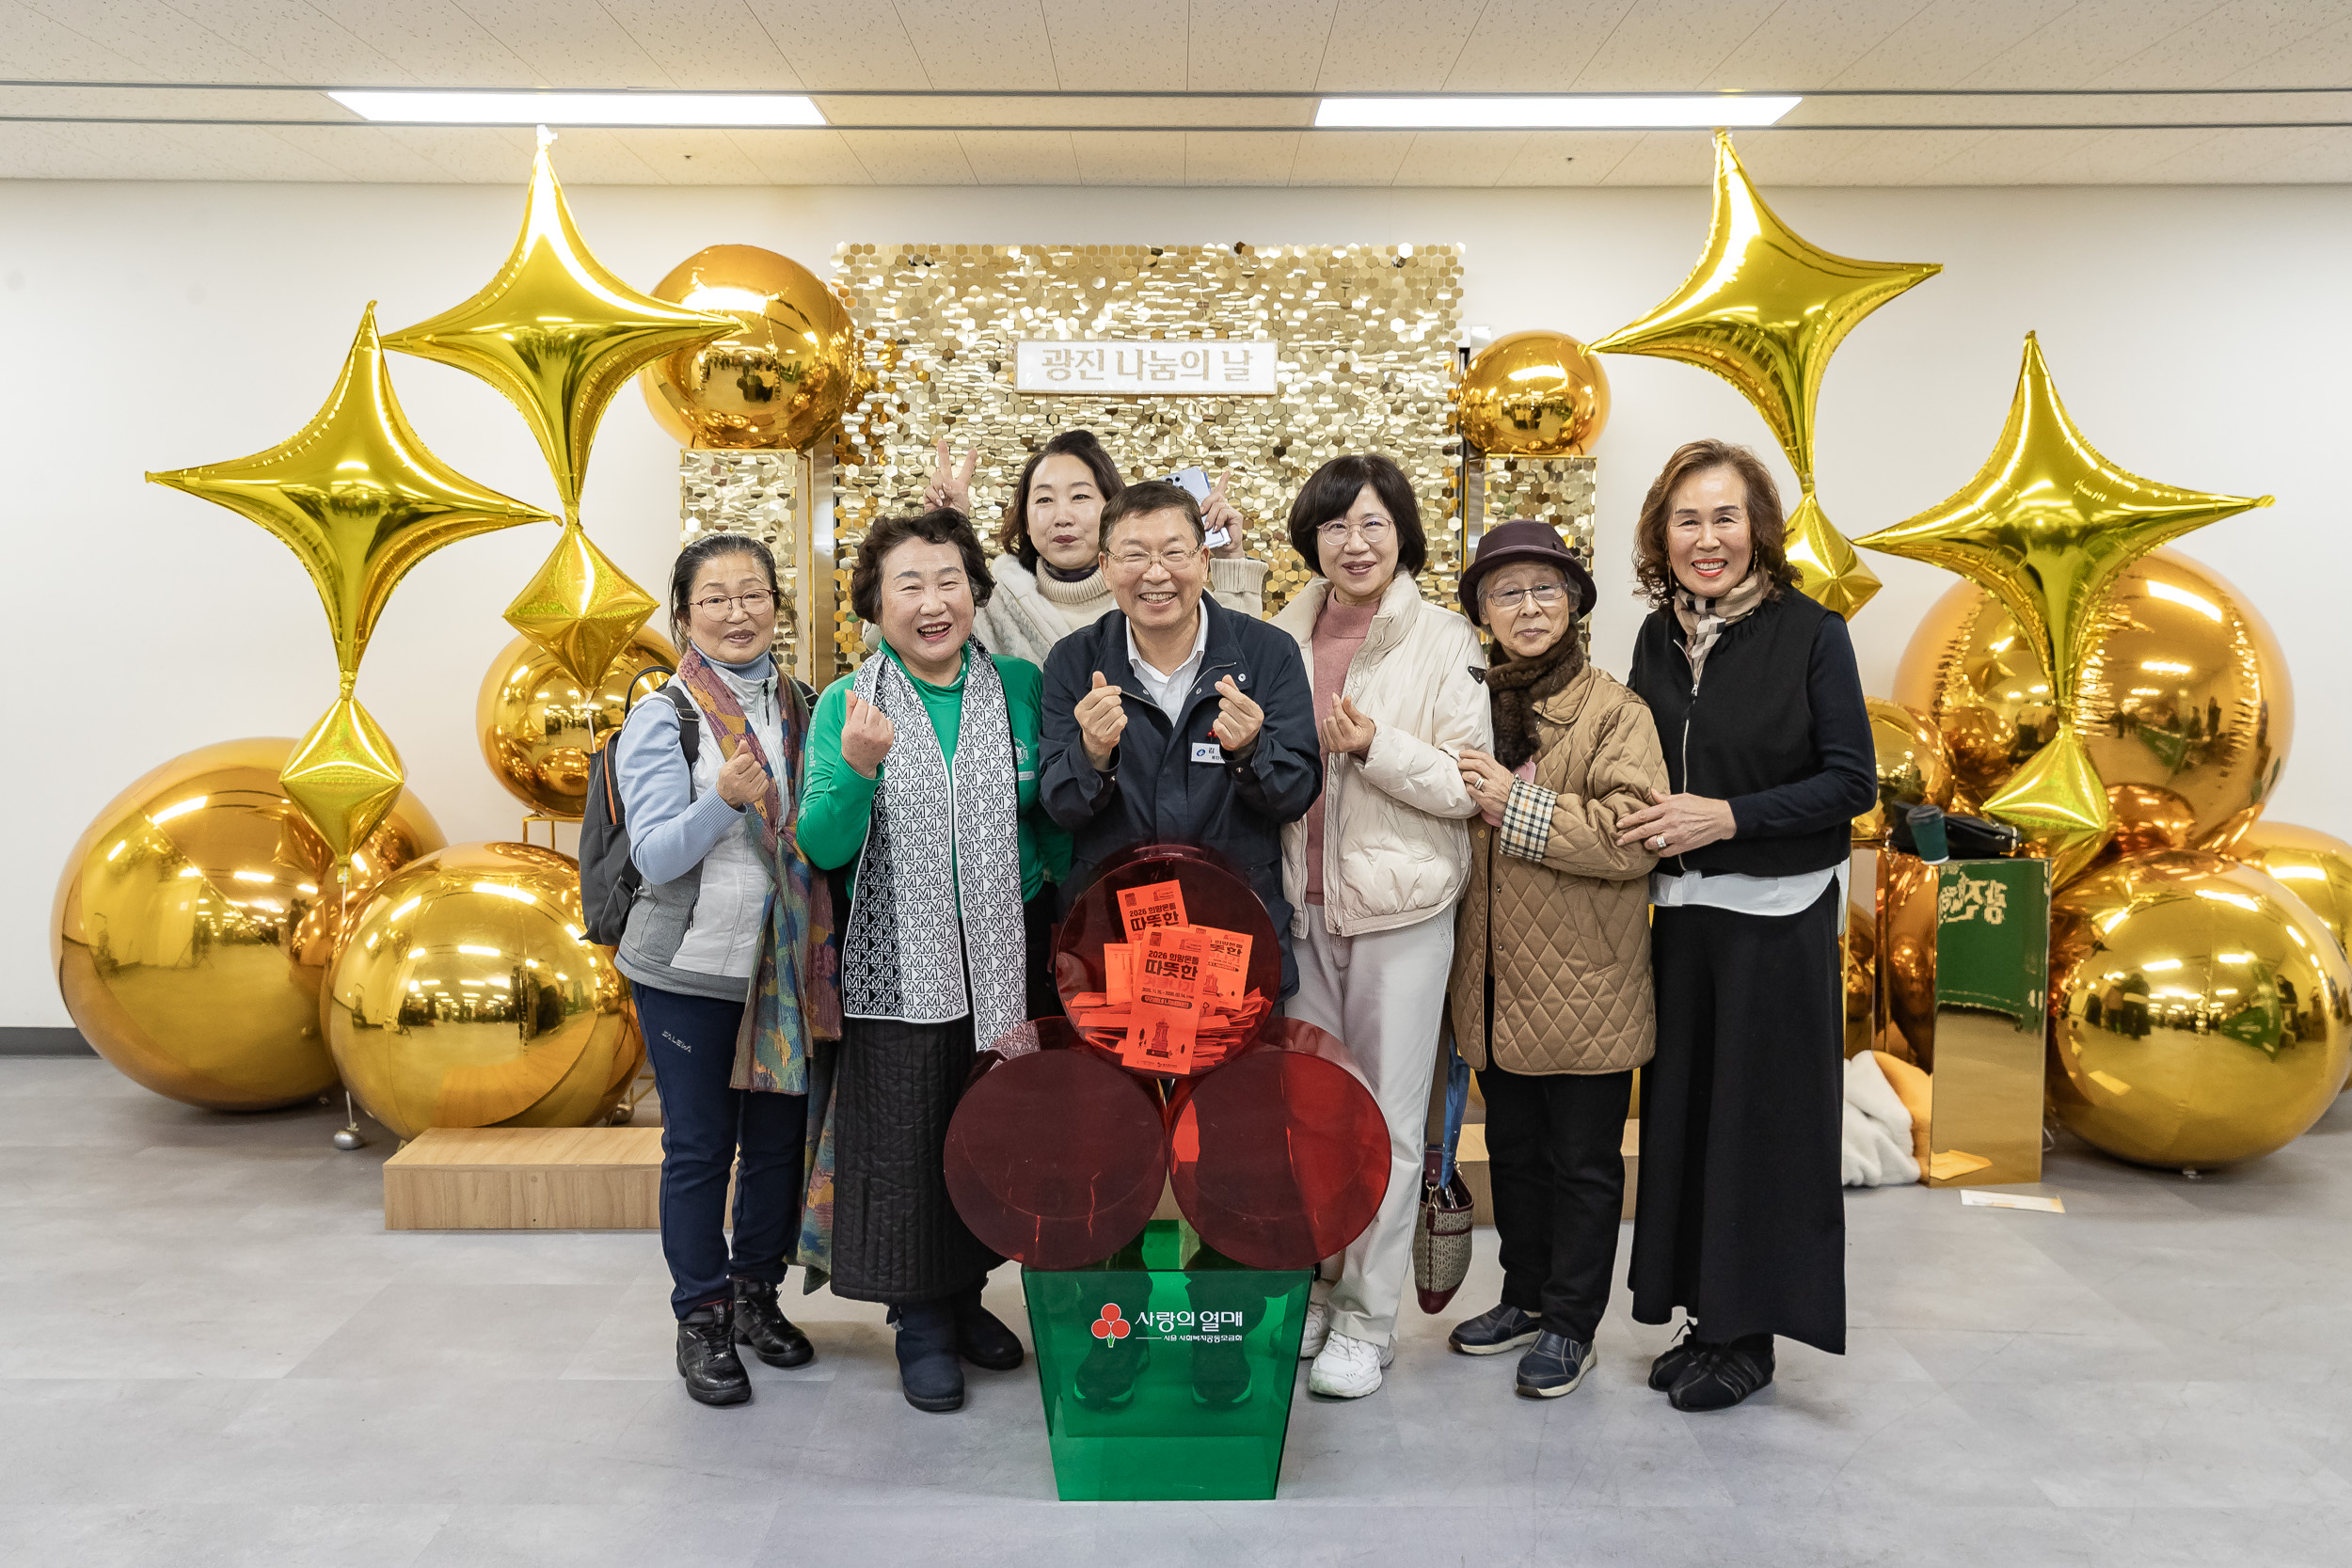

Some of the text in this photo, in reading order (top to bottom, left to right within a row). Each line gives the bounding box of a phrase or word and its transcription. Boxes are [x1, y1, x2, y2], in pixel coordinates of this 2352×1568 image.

[1041, 348, 1253, 382] 광진 나눔의 날
[1129, 909, 1147, 917] 2026
[1148, 950, 1168, 959] 2026
[1145, 958, 1199, 981] 따뜻한
[661, 1030, 691, 1053] SALEWA
[1135, 1310, 1243, 1333] 사랑의 열매
